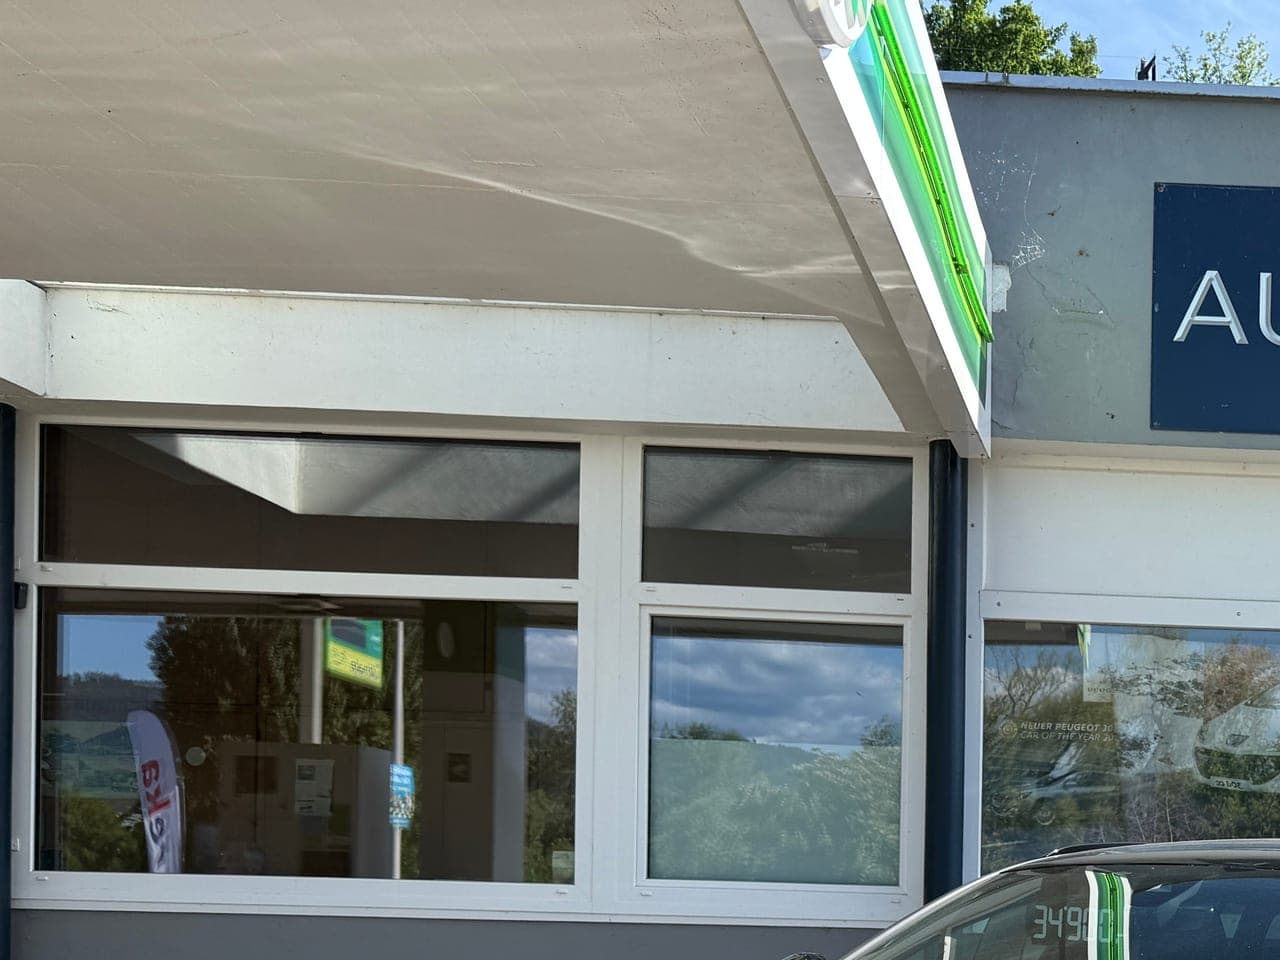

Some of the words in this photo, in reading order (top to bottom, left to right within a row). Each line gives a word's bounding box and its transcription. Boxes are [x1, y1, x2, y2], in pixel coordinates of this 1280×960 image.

[1021, 722, 1052, 730] NEUER
[1055, 723, 1101, 732] PEUGEOT
[1021, 731, 1040, 740] CAR
[1042, 732, 1055, 740] OF
[1057, 732, 1076, 740] THE
[1077, 733, 1101, 741] YEAR
